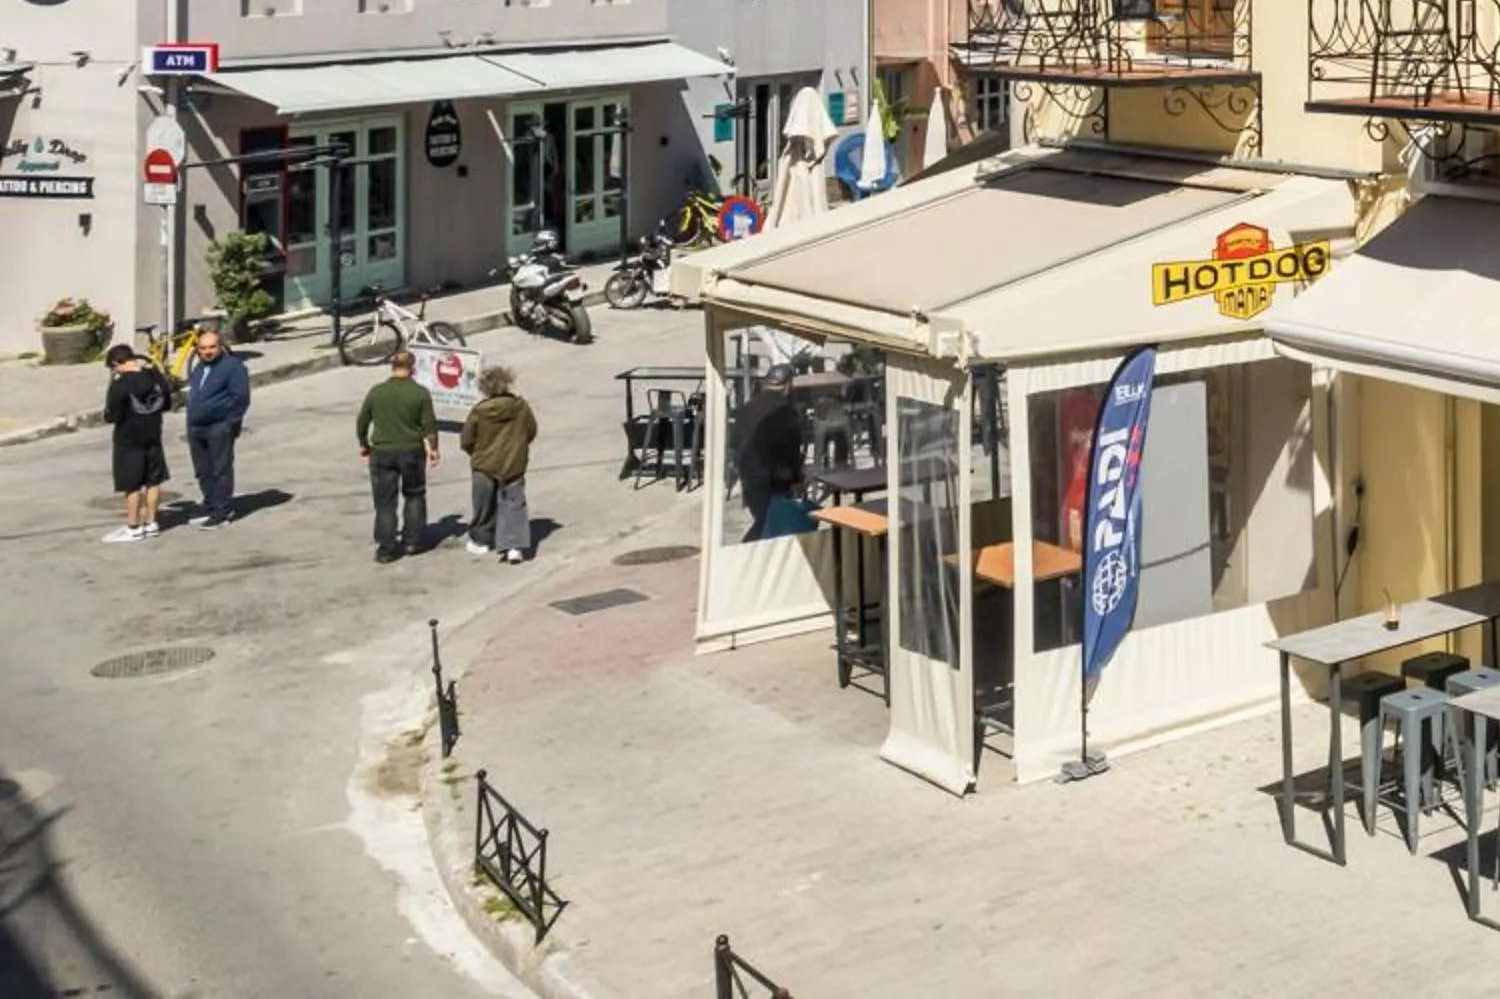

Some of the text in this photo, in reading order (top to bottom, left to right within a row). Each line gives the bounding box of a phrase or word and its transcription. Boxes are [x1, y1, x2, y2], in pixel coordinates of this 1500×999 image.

[165, 54, 195, 66] ATM
[29, 181, 37, 193] &
[39, 181, 87, 194] PIERCING
[1163, 246, 1326, 300] HOTDOG
[1224, 286, 1268, 314] MANIA
[1094, 427, 1129, 552] PADI
